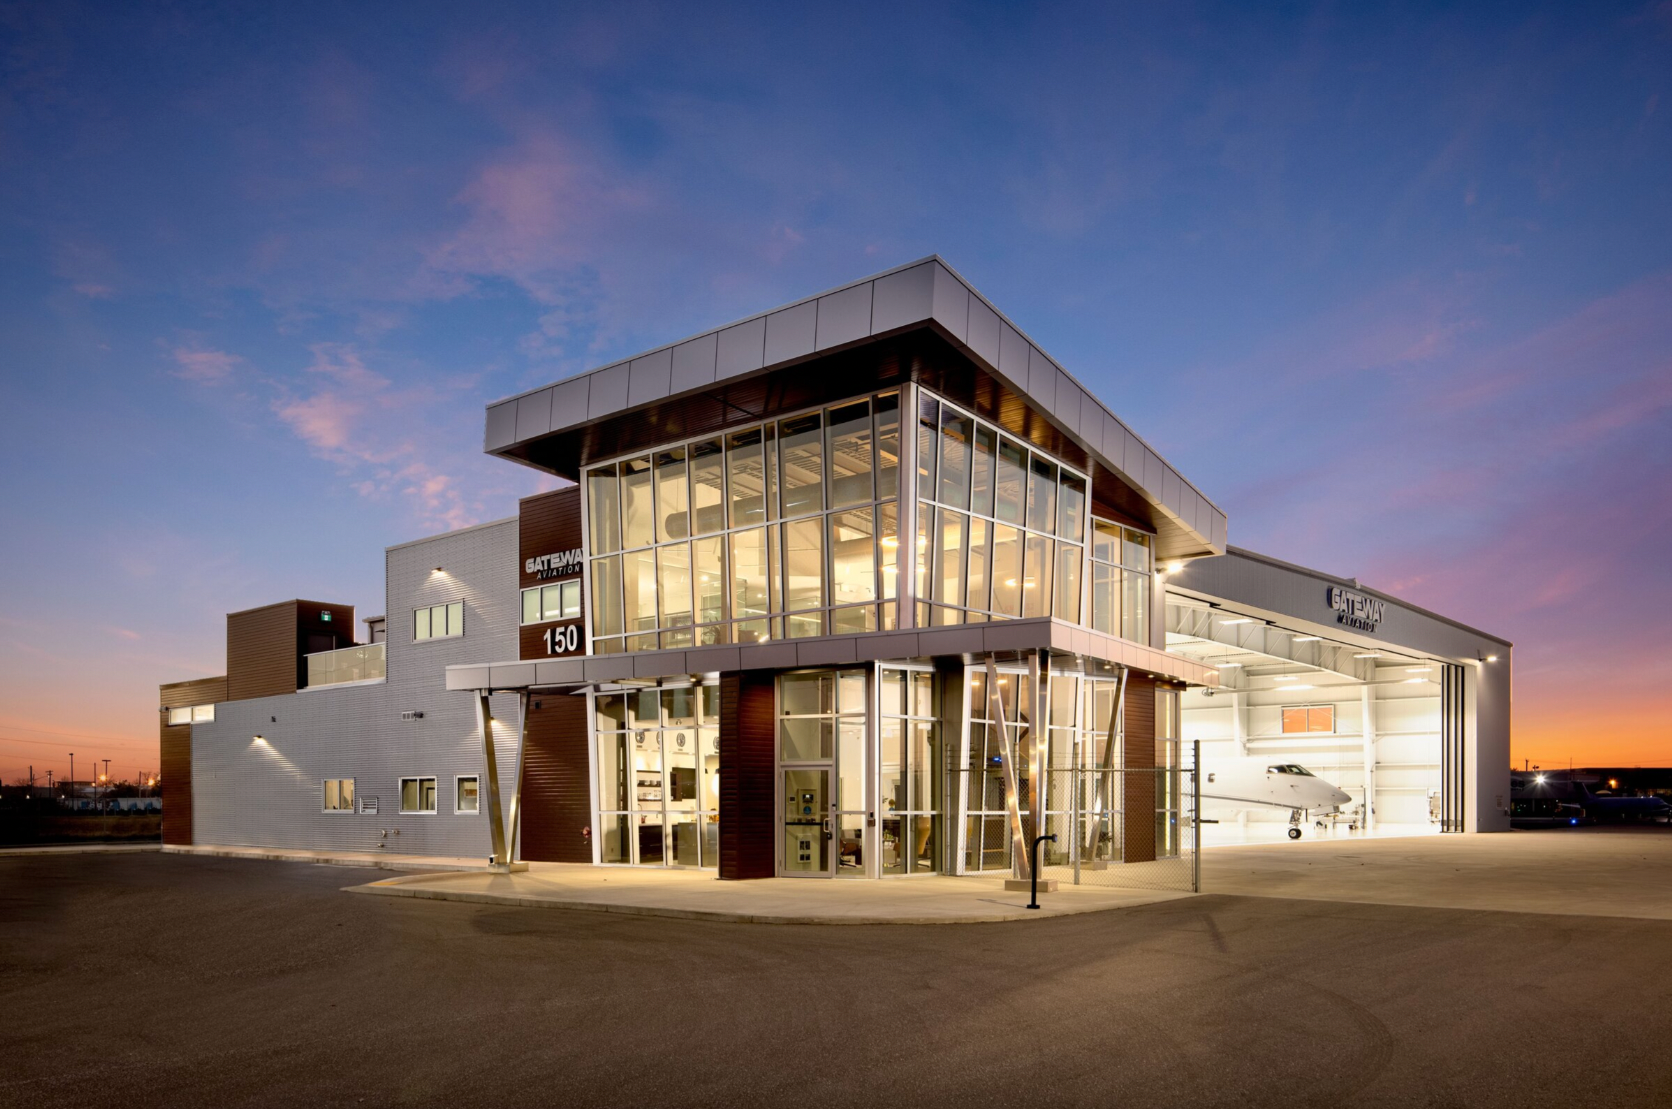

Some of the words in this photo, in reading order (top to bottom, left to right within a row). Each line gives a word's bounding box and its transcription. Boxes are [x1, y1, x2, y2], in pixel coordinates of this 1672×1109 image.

[525, 547, 583, 574] GATEWA
[536, 564, 580, 580] AVIATION
[1330, 587, 1386, 623] GATEWAY
[1341, 614, 1378, 633] AVIATION
[543, 624, 578, 655] 150
